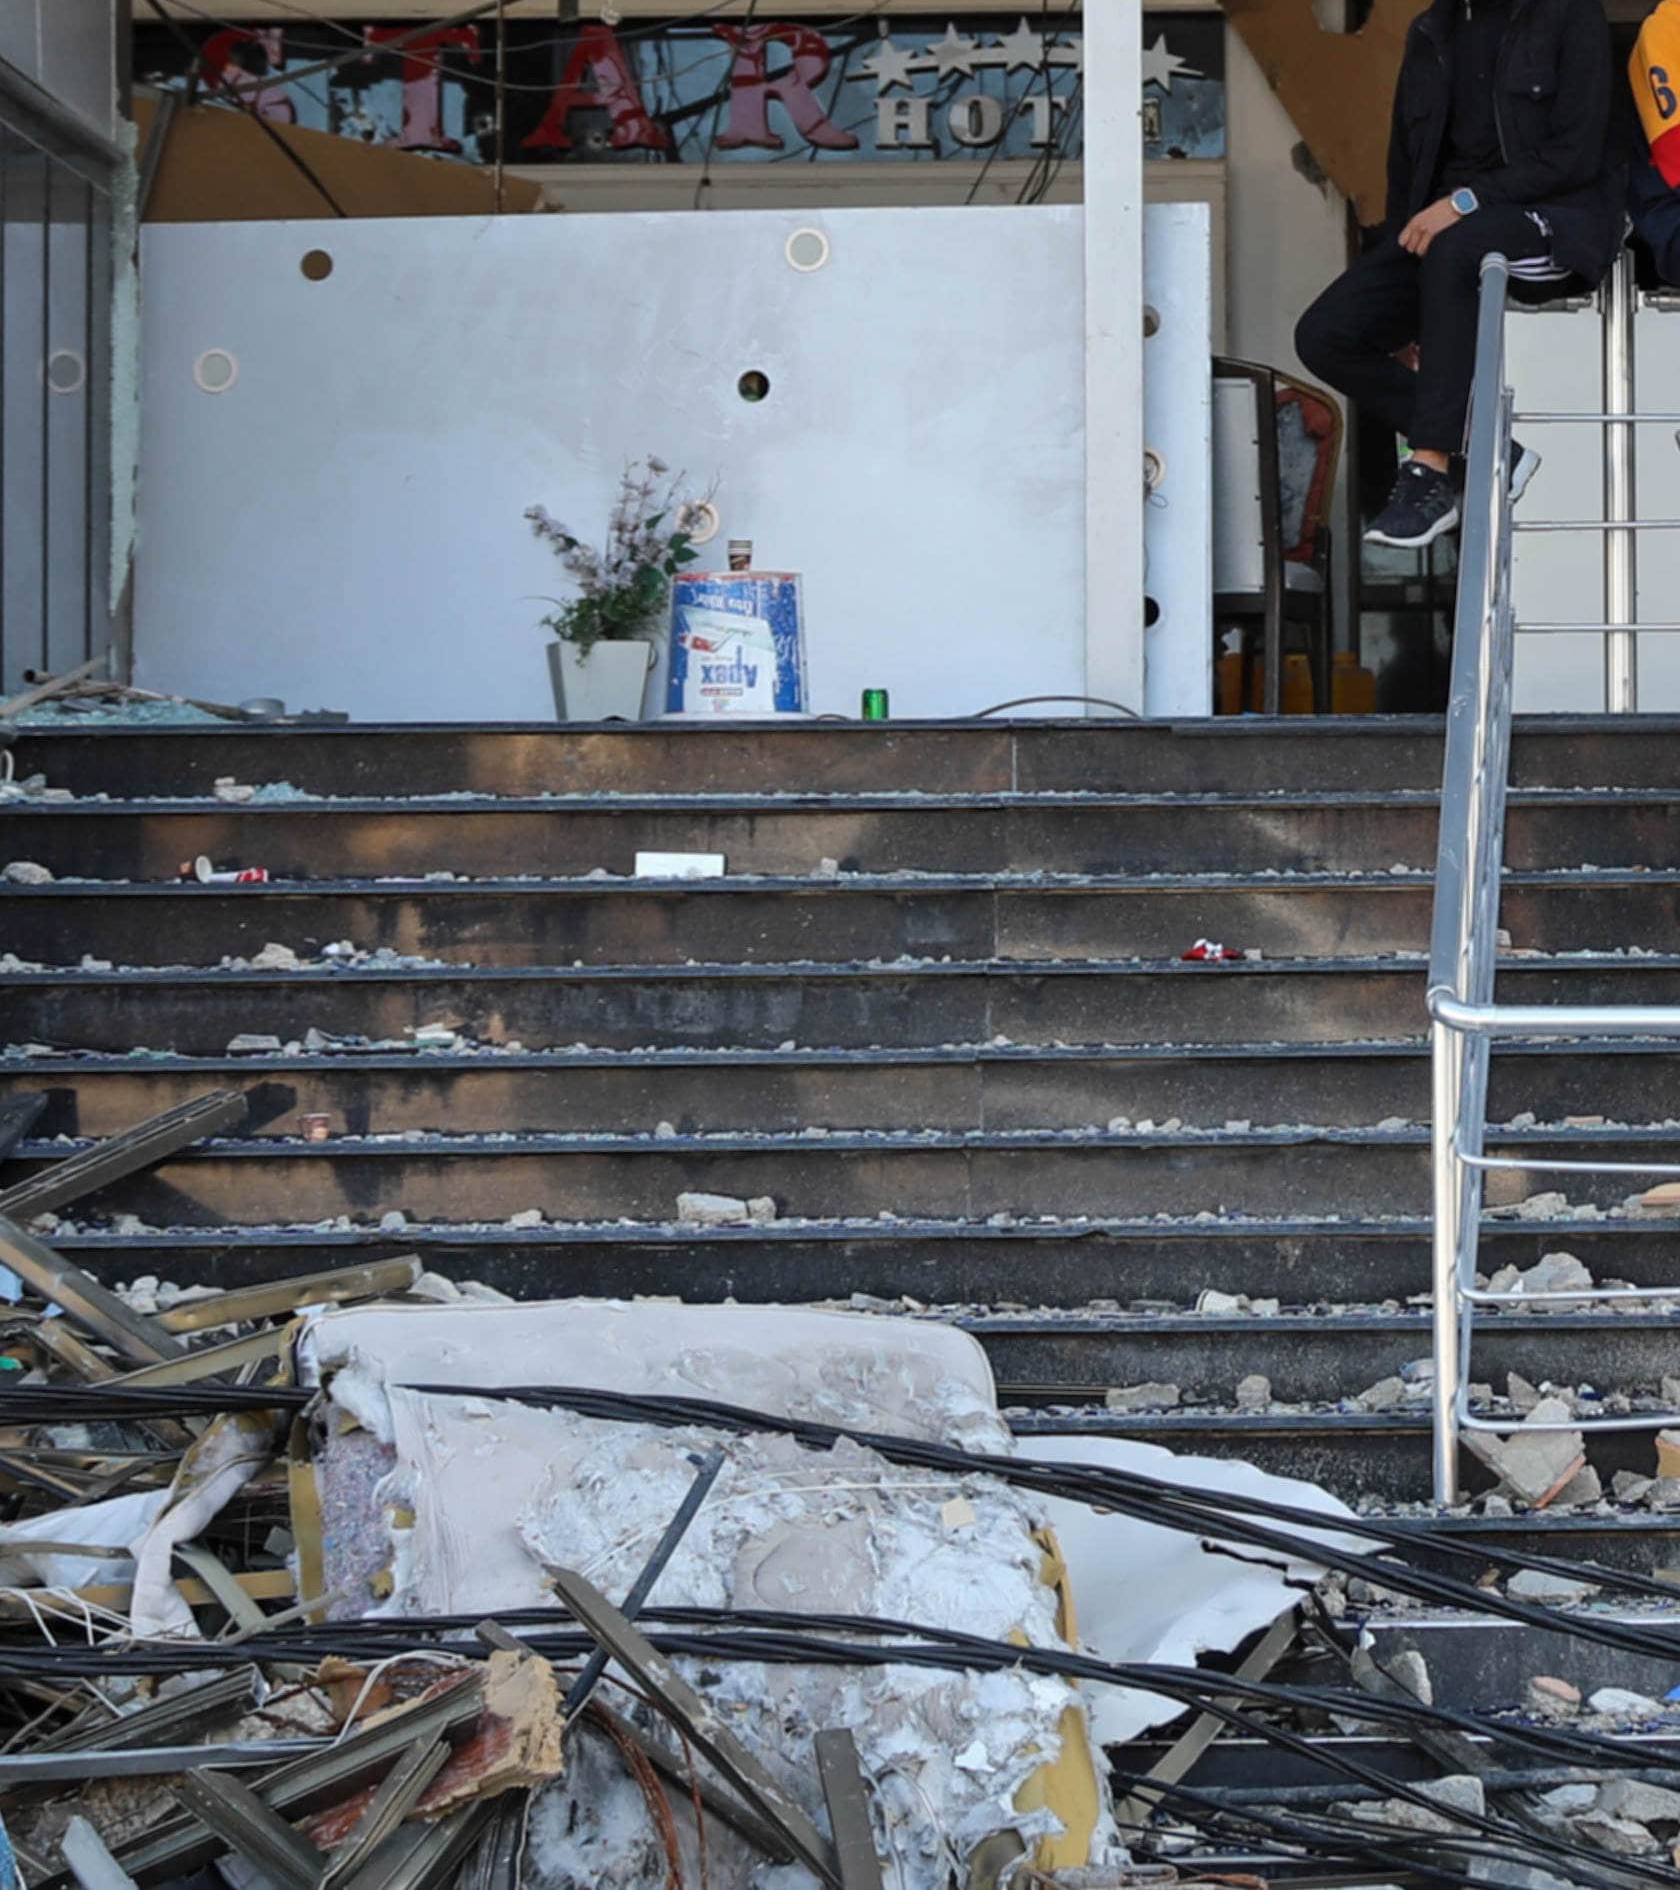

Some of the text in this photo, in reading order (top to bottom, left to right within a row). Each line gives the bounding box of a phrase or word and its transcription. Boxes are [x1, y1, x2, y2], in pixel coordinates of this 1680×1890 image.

[202, 21, 860, 150] STAR
[873, 94, 1161, 148] HOT
[701, 644, 758, 688] Apex
